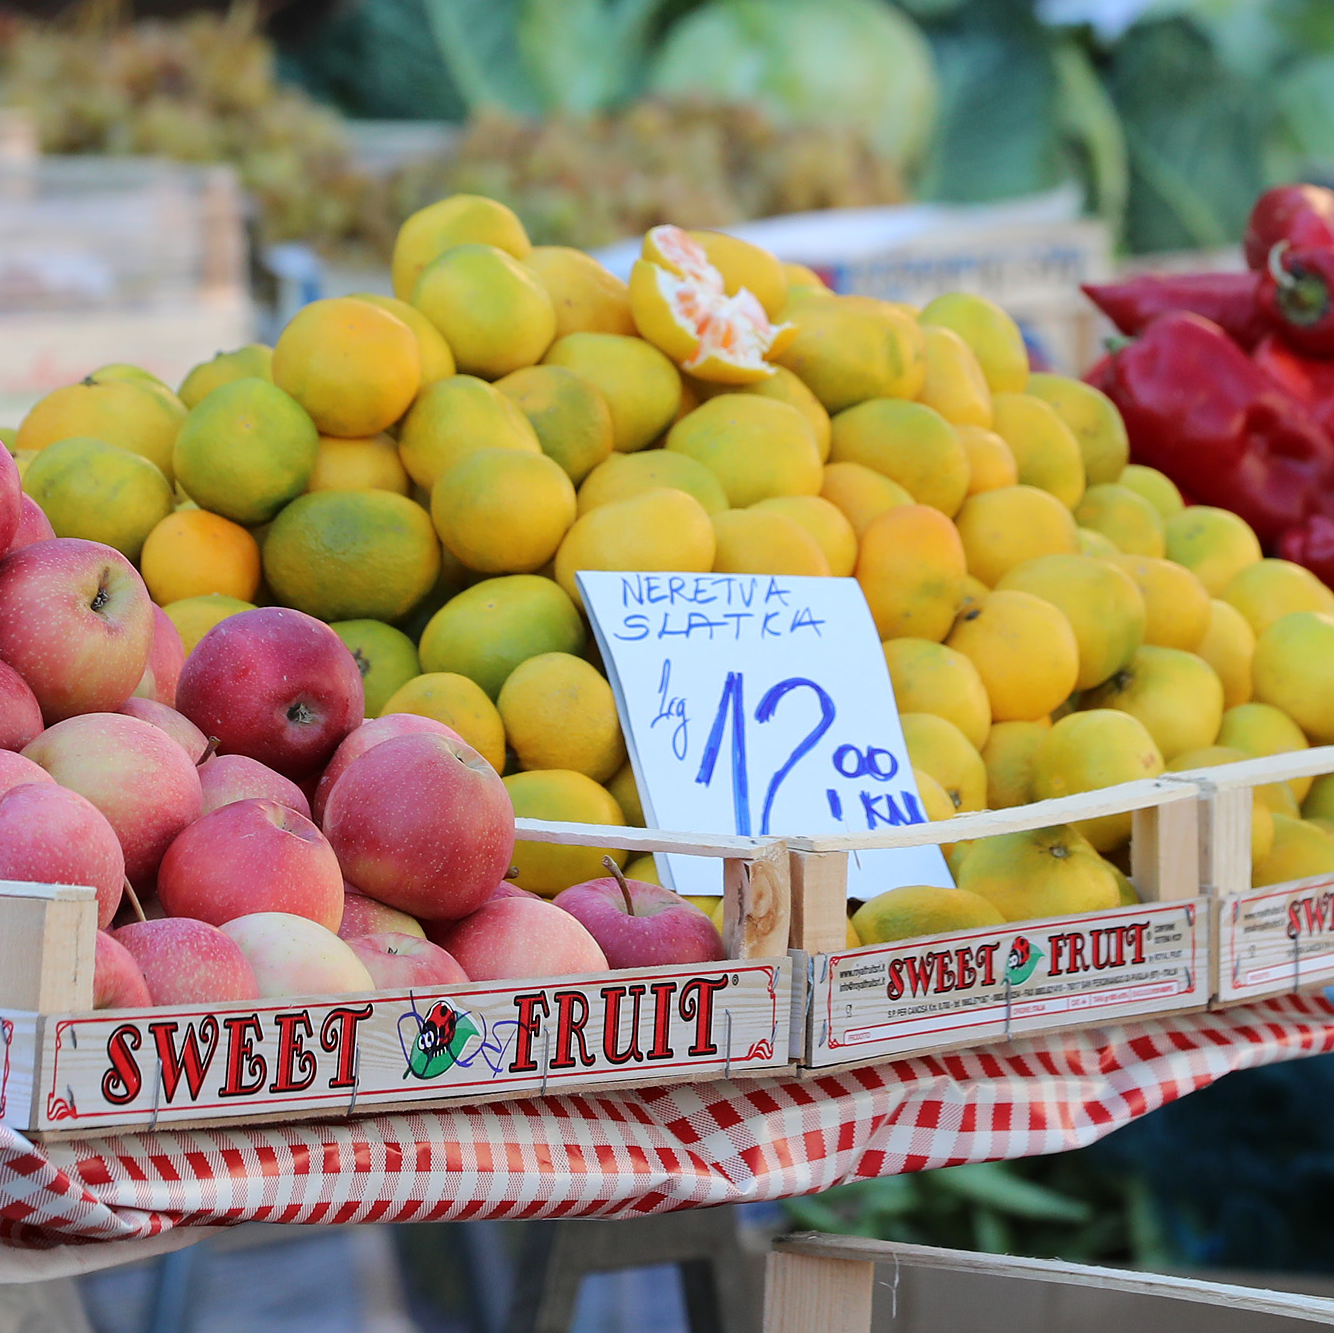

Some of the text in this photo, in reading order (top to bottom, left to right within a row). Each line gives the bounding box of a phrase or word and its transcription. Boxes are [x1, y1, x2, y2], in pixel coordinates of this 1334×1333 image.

[622, 575, 791, 609] NERETVA
[613, 607, 826, 642] SLATKA
[887, 921, 1151, 1001] SWEET FRUIT
[102, 973, 729, 1105] SWEET FRUIT
